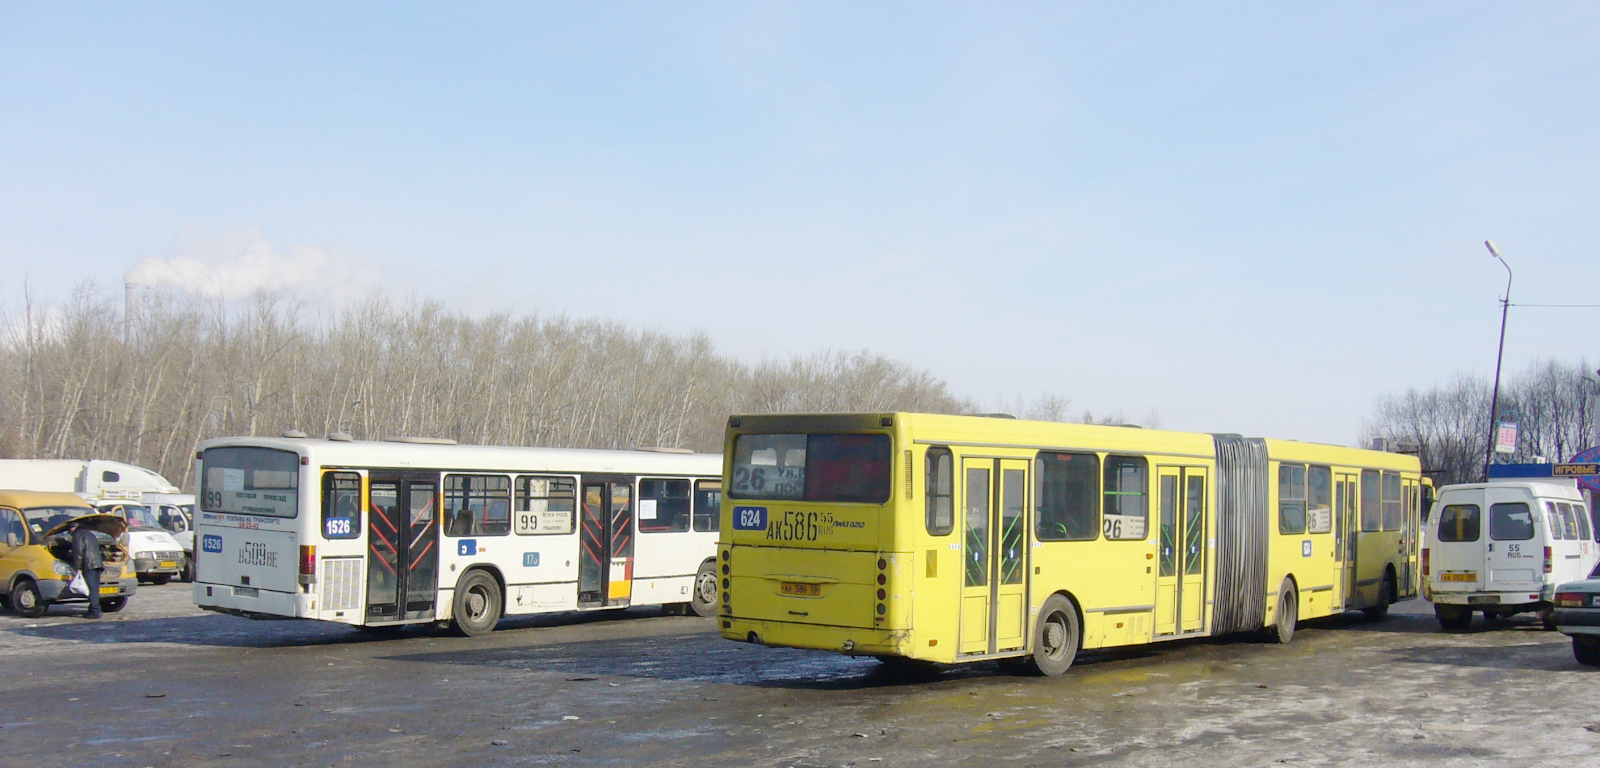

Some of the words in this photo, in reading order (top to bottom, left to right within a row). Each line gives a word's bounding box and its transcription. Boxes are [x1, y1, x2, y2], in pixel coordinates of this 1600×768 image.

[1554, 465, 1597, 474] ИГРОВЫЕ
[733, 467, 765, 491] 26
[208, 491, 222, 508] 99
[520, 514, 538, 531] 99
[740, 509, 760, 527] 624
[820, 512, 834, 524] 55
[326, 519, 350, 535] 1526
[818, 525, 834, 536] RUS
[1104, 519, 1122, 539] 26
[203, 537, 221, 550] 1526
[1508, 544, 1520, 552] 55
